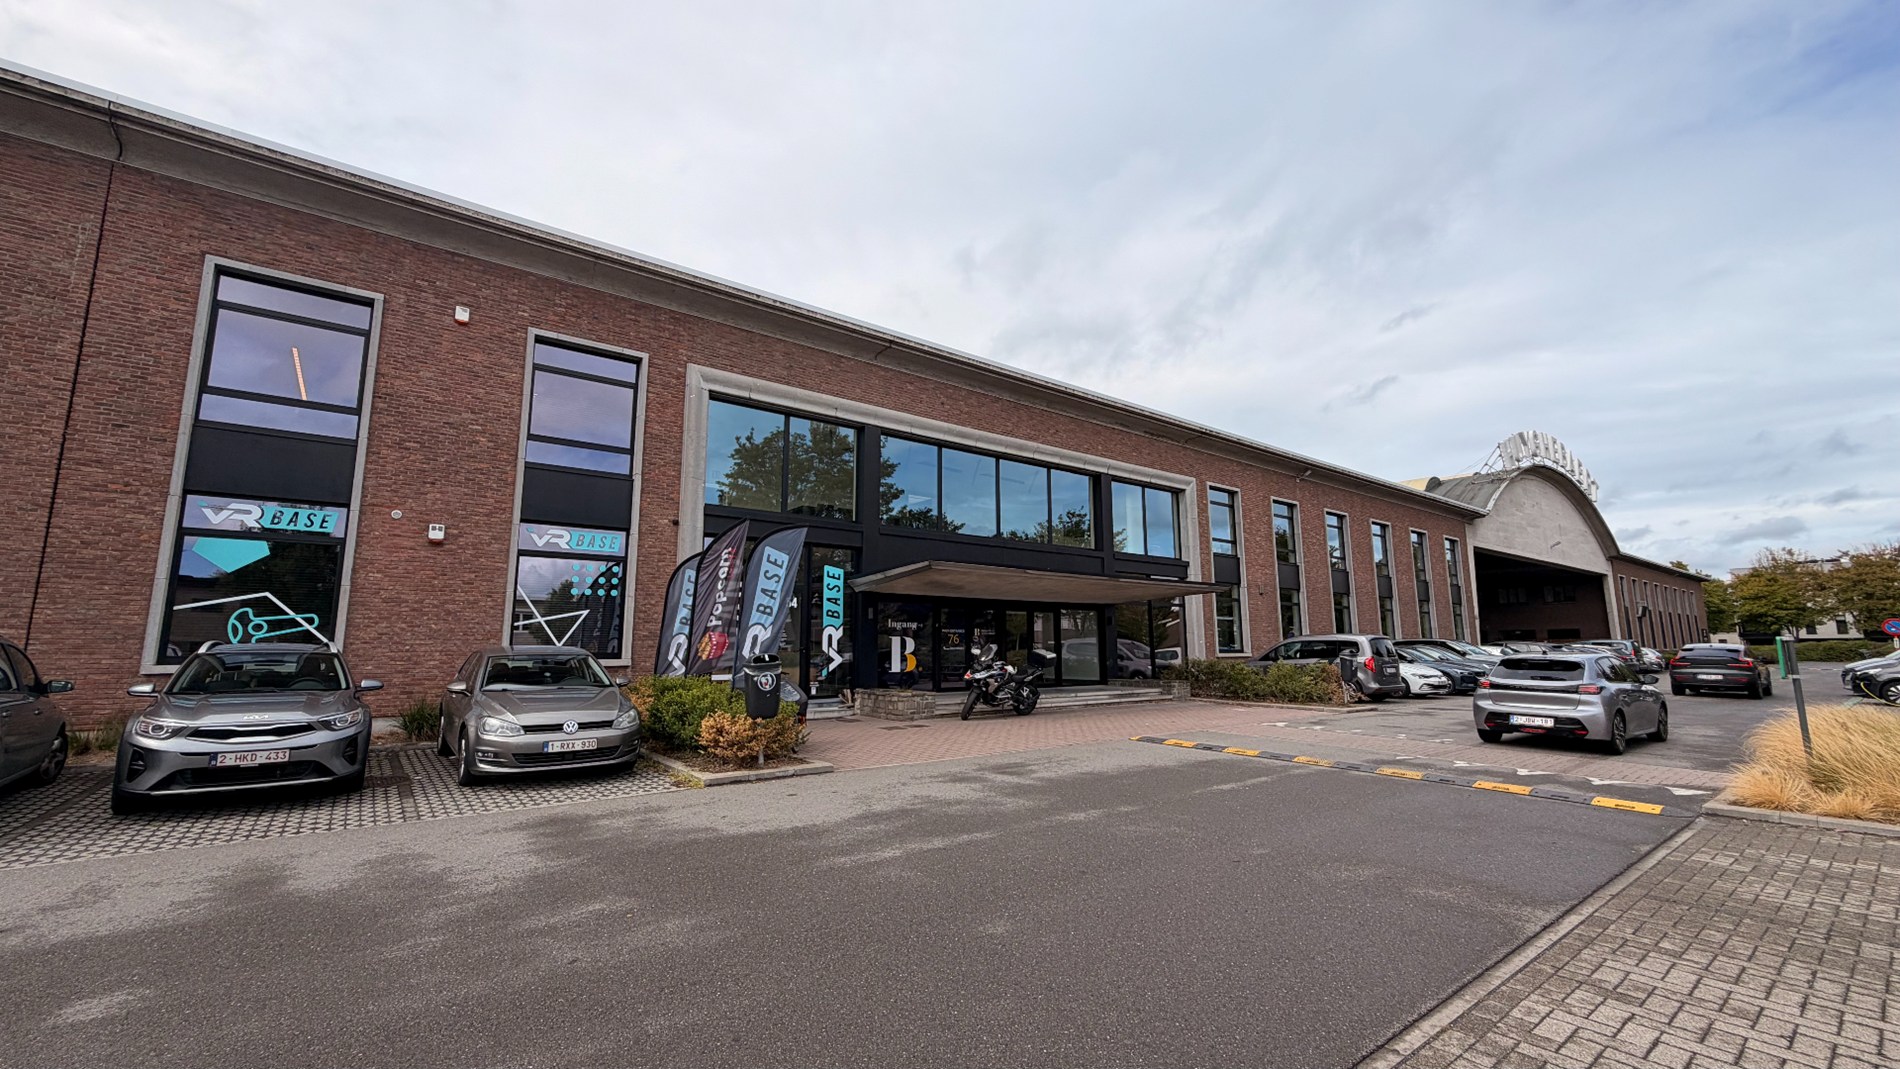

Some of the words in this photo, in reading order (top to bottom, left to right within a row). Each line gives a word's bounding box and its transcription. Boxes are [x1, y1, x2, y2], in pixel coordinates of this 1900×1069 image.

[269, 510, 333, 529] BASE
[575, 534, 618, 550] BASE
[755, 553, 785, 618] BASE
[826, 570, 841, 619] BASE
[887, 619, 918, 630] Ingang
[947, 634, 960, 645] 76
[551, 740, 597, 751] 1-RXX-930
[219, 750, 287, 764] 2-HKD-433
